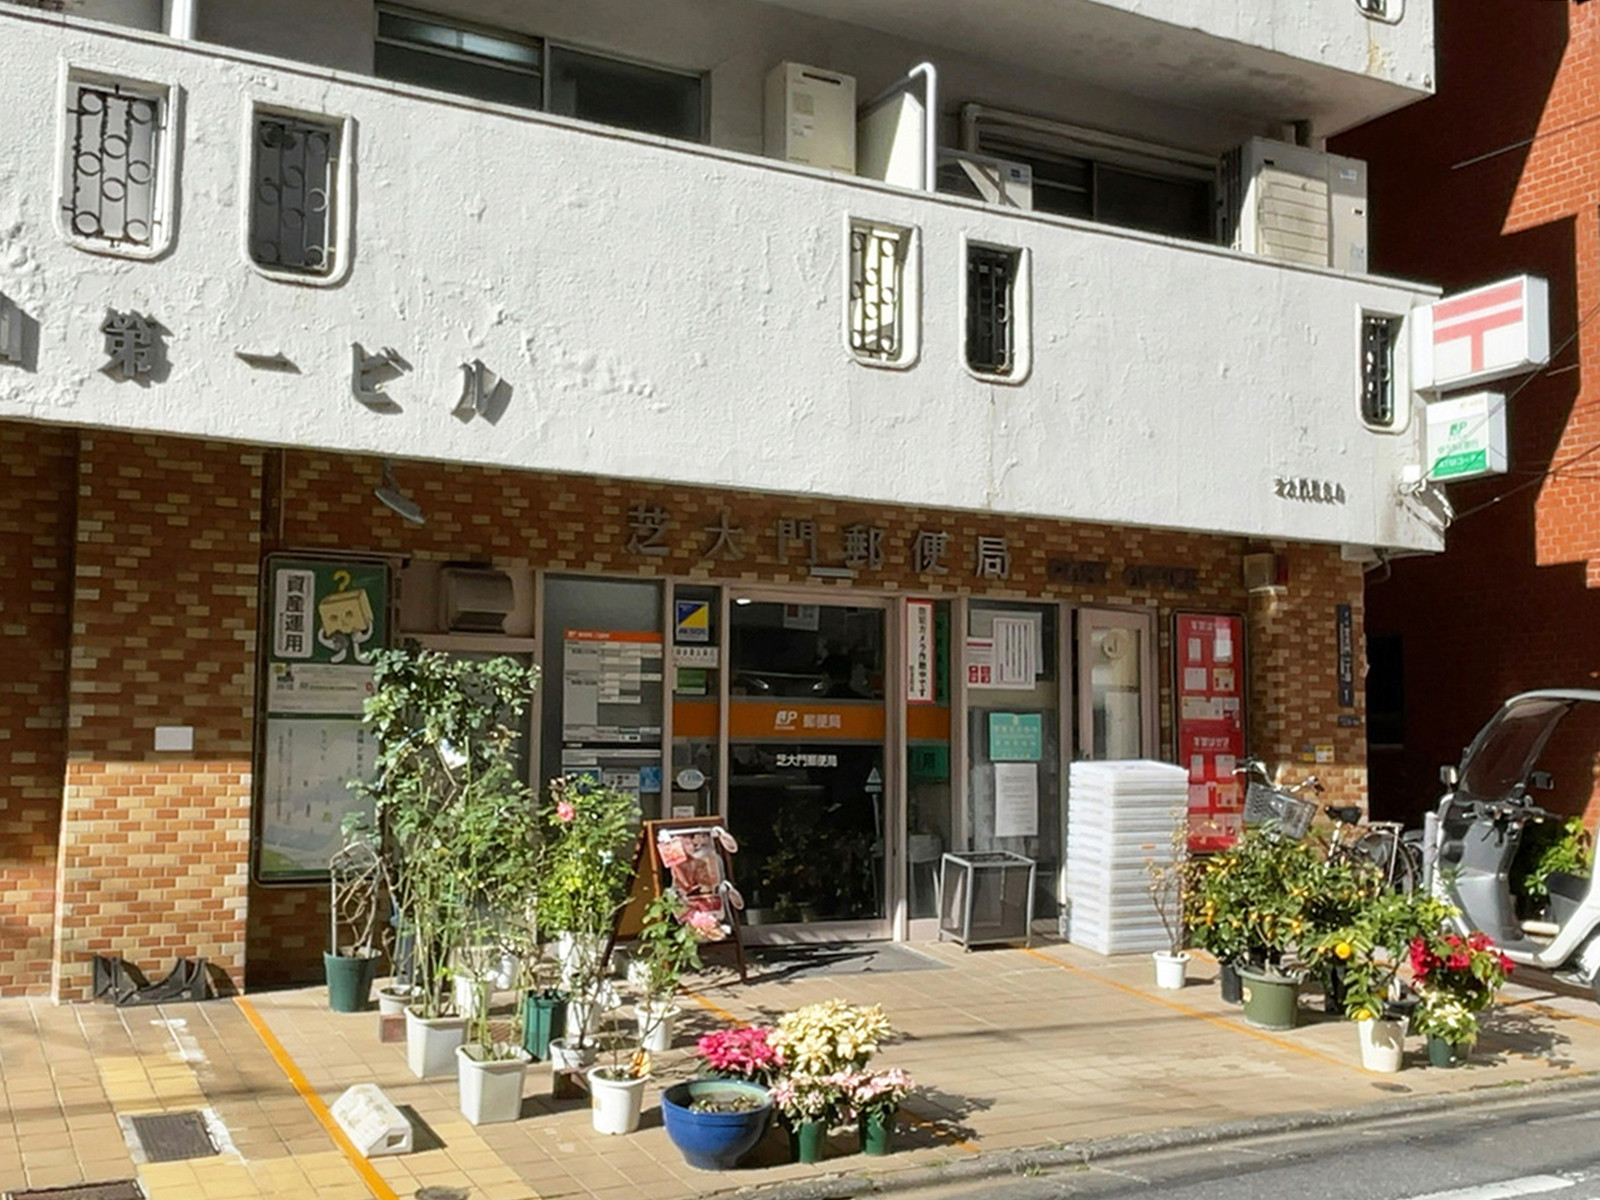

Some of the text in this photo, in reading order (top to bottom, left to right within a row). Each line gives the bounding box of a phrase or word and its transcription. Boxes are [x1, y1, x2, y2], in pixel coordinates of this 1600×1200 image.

[626, 502, 1011, 580] 芝大門郵便局
[775, 753, 838, 768] 芝大門郵便局
